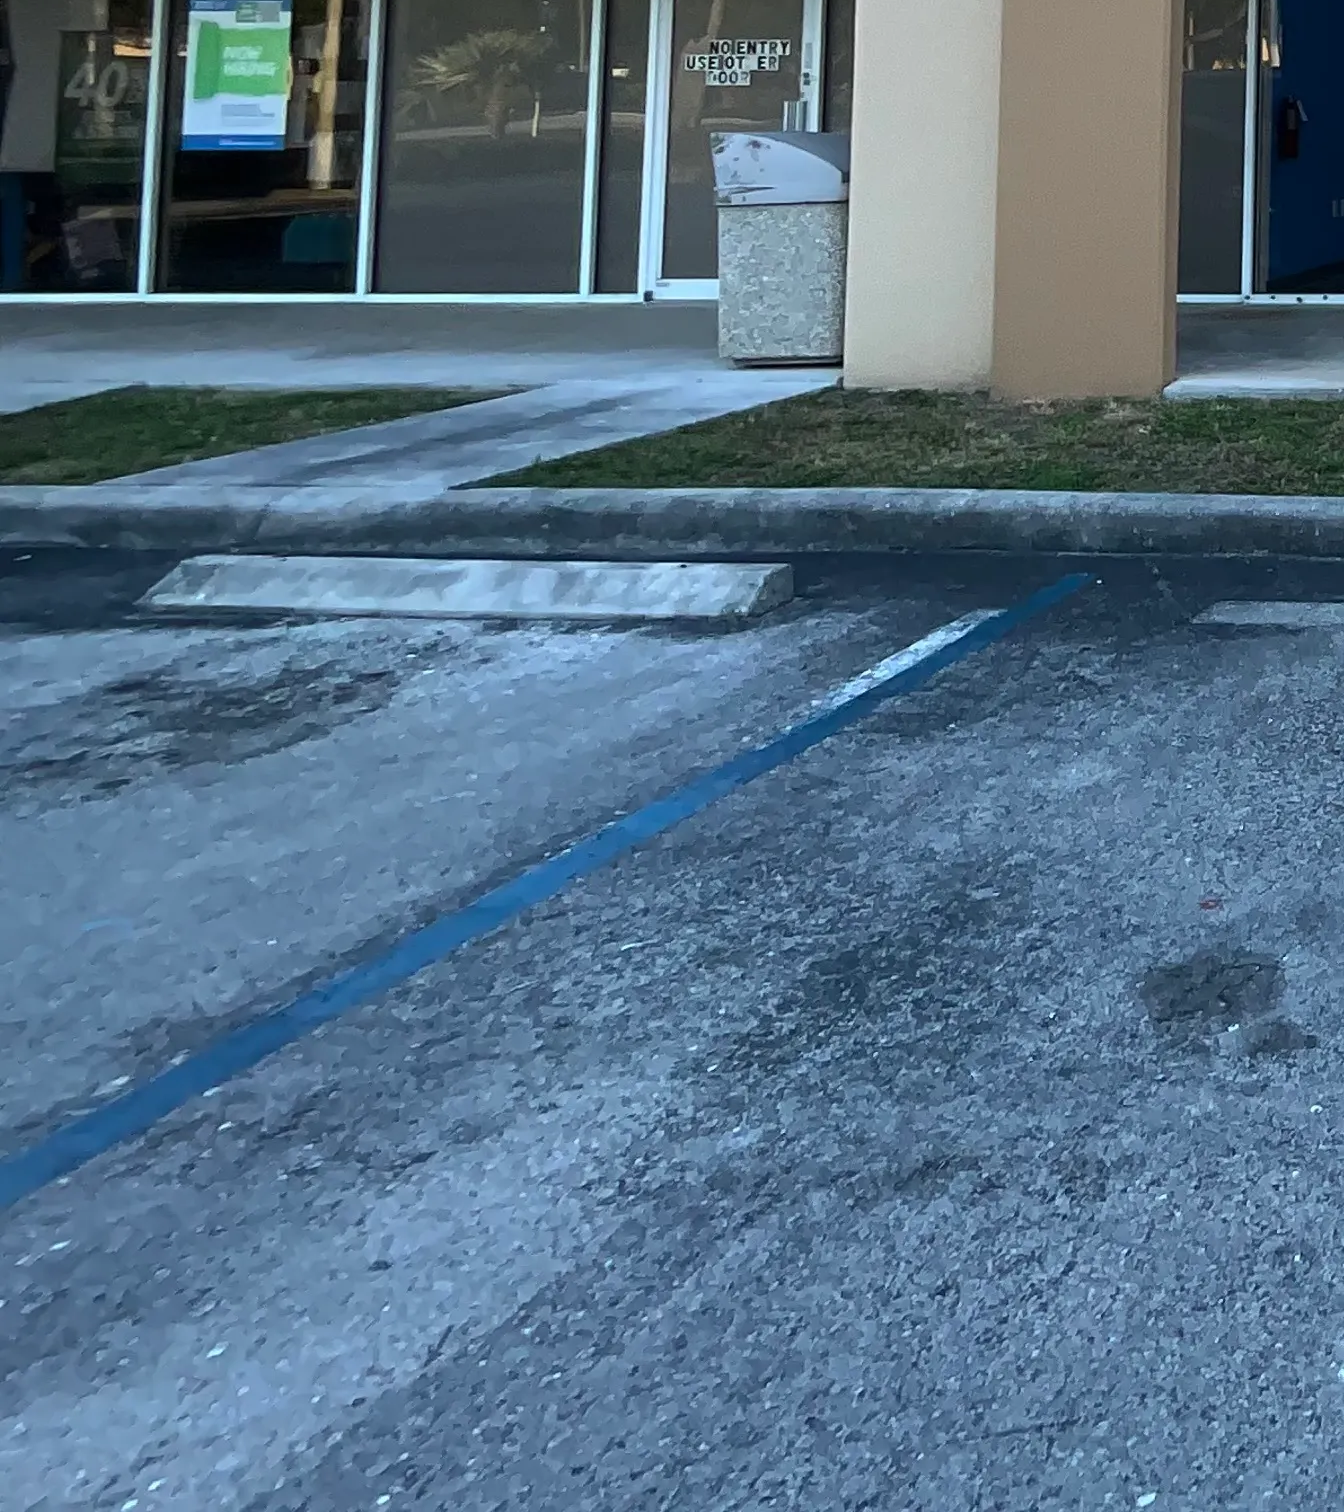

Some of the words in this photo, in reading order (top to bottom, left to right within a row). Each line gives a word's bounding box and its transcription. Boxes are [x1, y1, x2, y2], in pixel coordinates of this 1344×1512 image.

[710, 41, 731, 55] NO
[736, 41, 790, 55] ENTRY
[686, 56, 718, 70] USE
[724, 56, 778, 70] OTER
